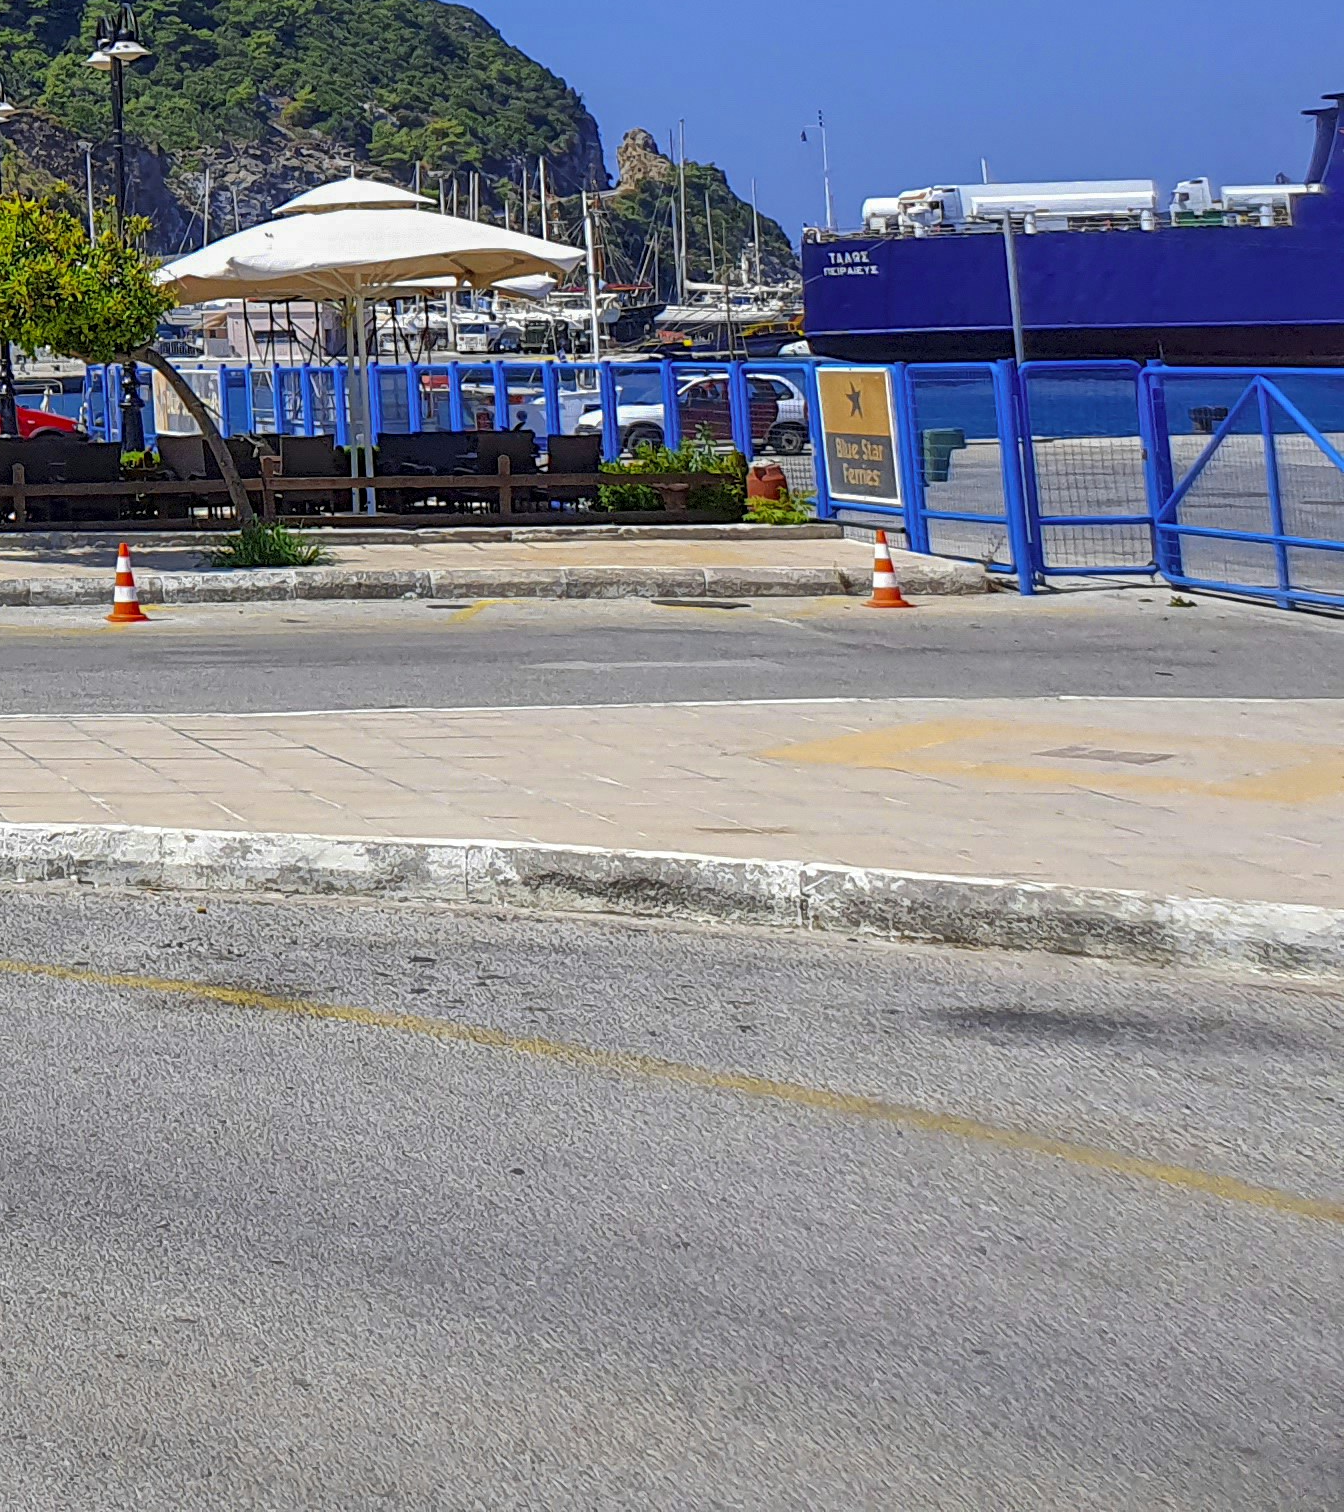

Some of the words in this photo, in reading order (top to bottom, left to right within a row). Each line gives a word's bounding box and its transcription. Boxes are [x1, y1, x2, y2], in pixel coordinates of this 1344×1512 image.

[835, 437, 859, 459] Blue
[861, 439, 883, 461] Star
[842, 463, 881, 486] Ferries
